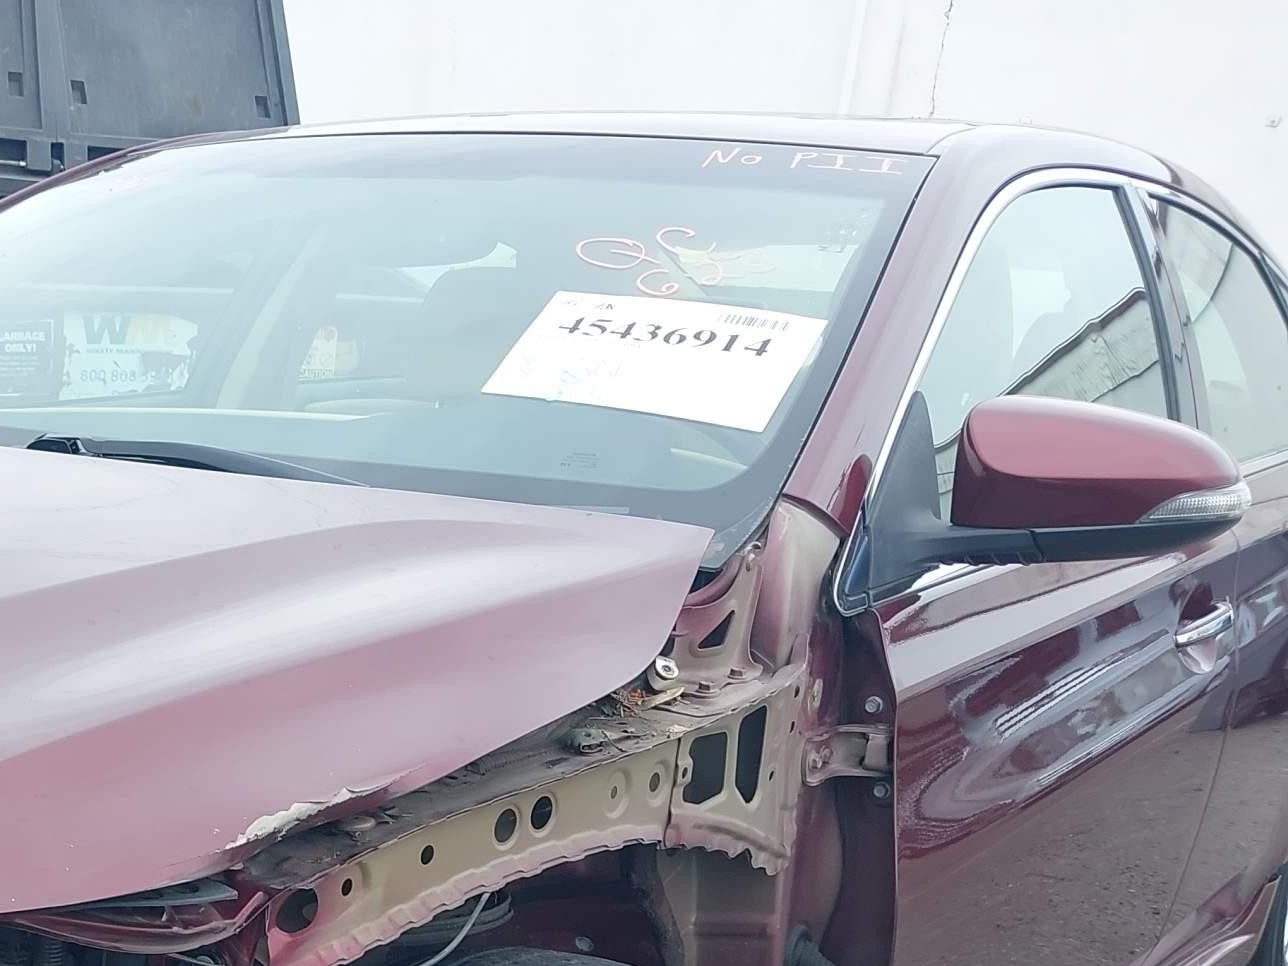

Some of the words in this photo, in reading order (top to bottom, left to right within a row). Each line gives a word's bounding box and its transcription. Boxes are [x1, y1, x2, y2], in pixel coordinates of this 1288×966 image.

[701, 147, 762, 168] No
[790, 151, 910, 175] PII
[557, 316, 773, 357] 45436914
